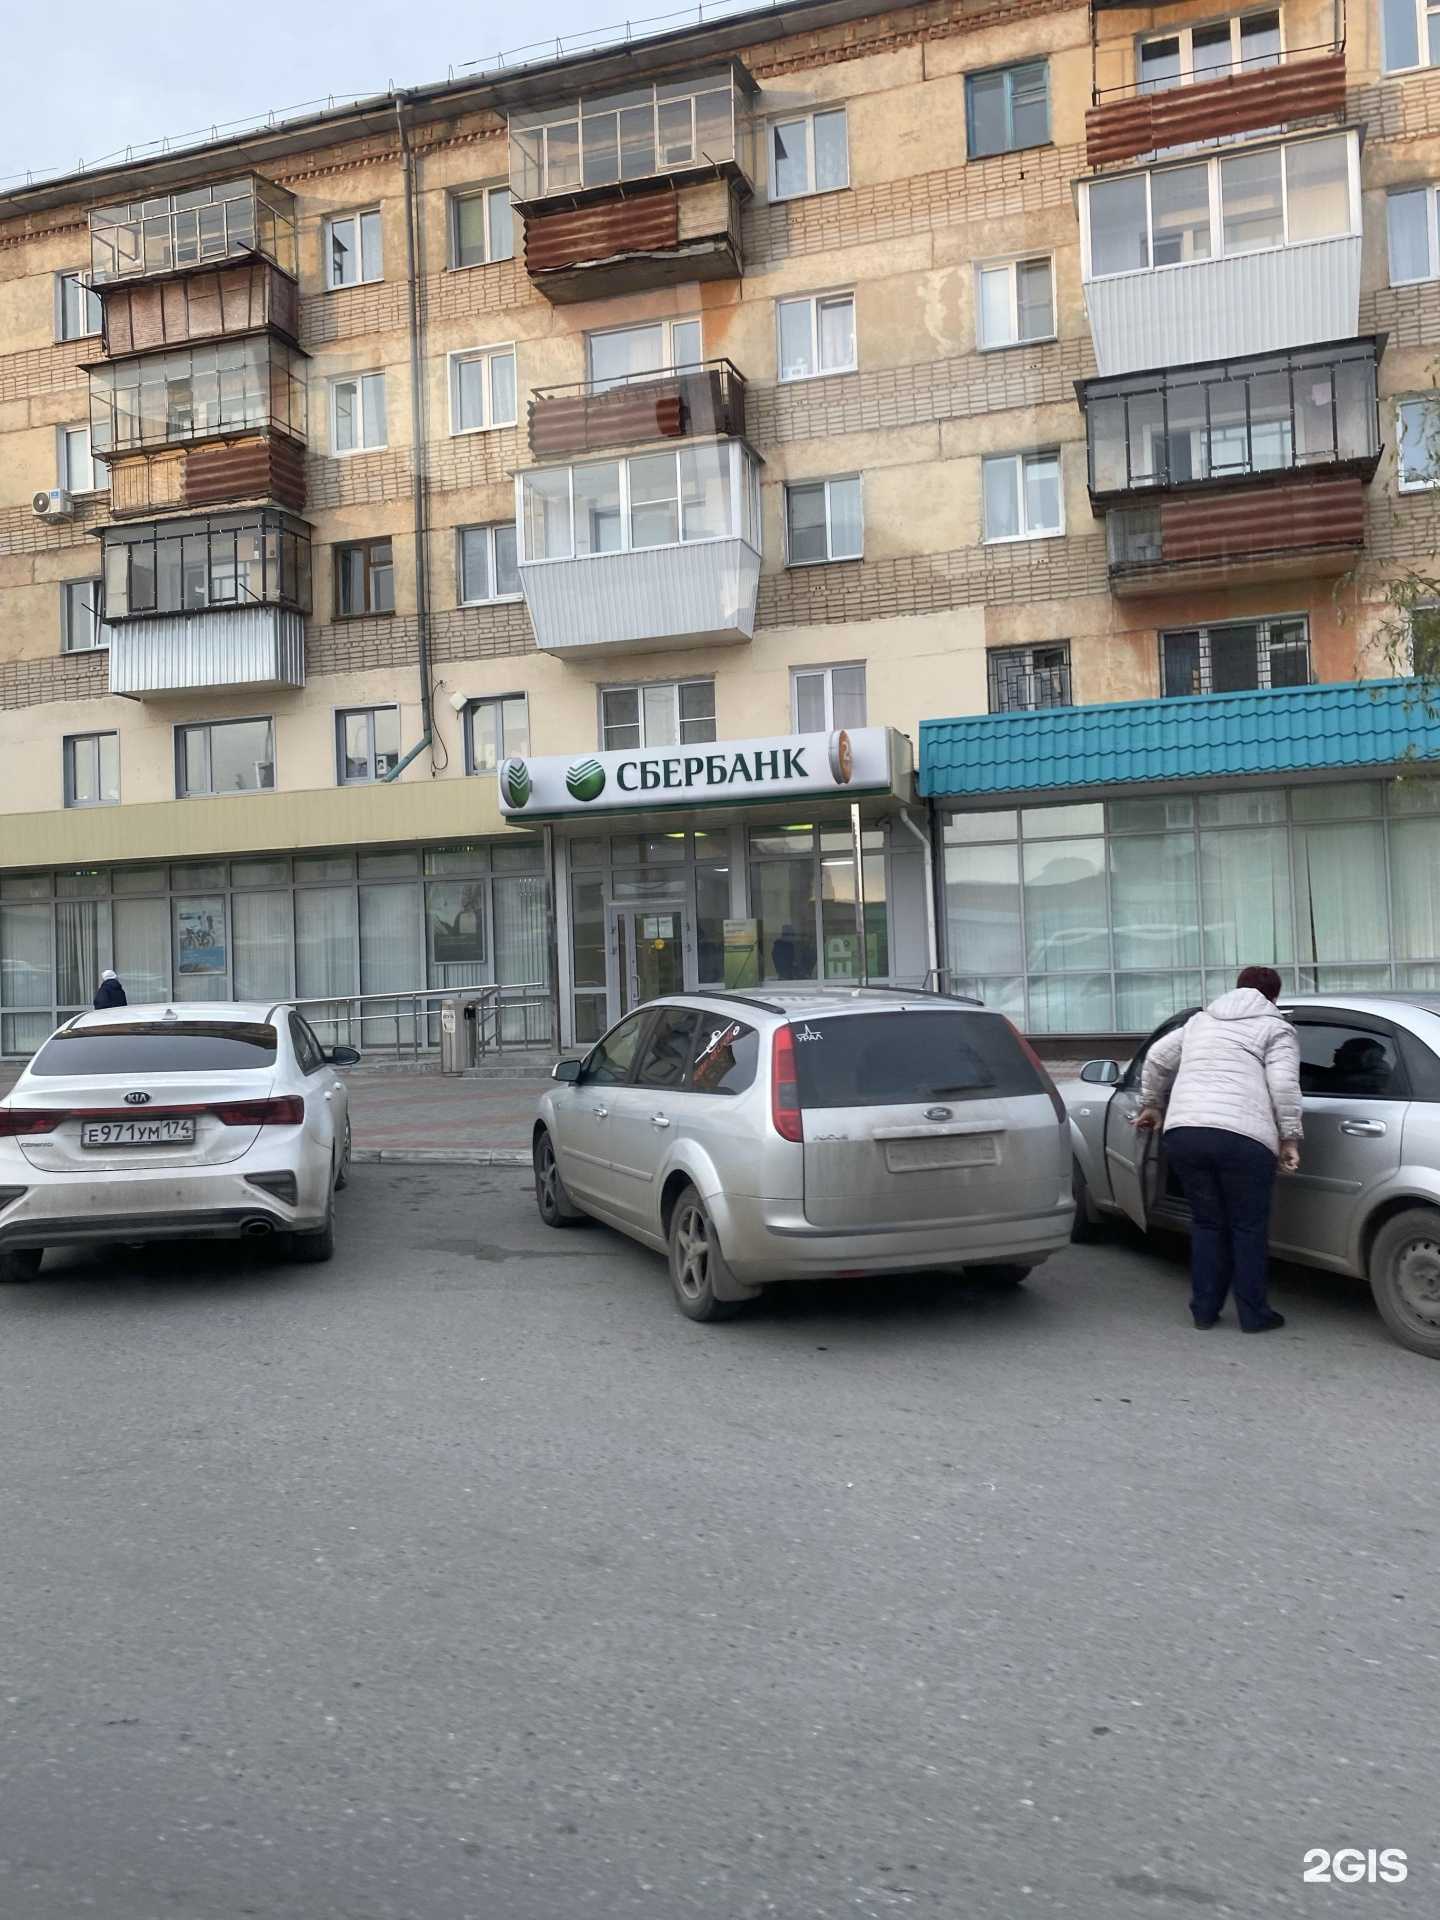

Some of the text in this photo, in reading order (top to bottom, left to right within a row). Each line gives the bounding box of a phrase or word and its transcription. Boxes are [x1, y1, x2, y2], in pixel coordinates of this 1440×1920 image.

[616, 747, 809, 792] СБЕРБАНК
[127, 1093, 148, 1103] KIA
[88, 1120, 190, 1143] Е971УМ 174
